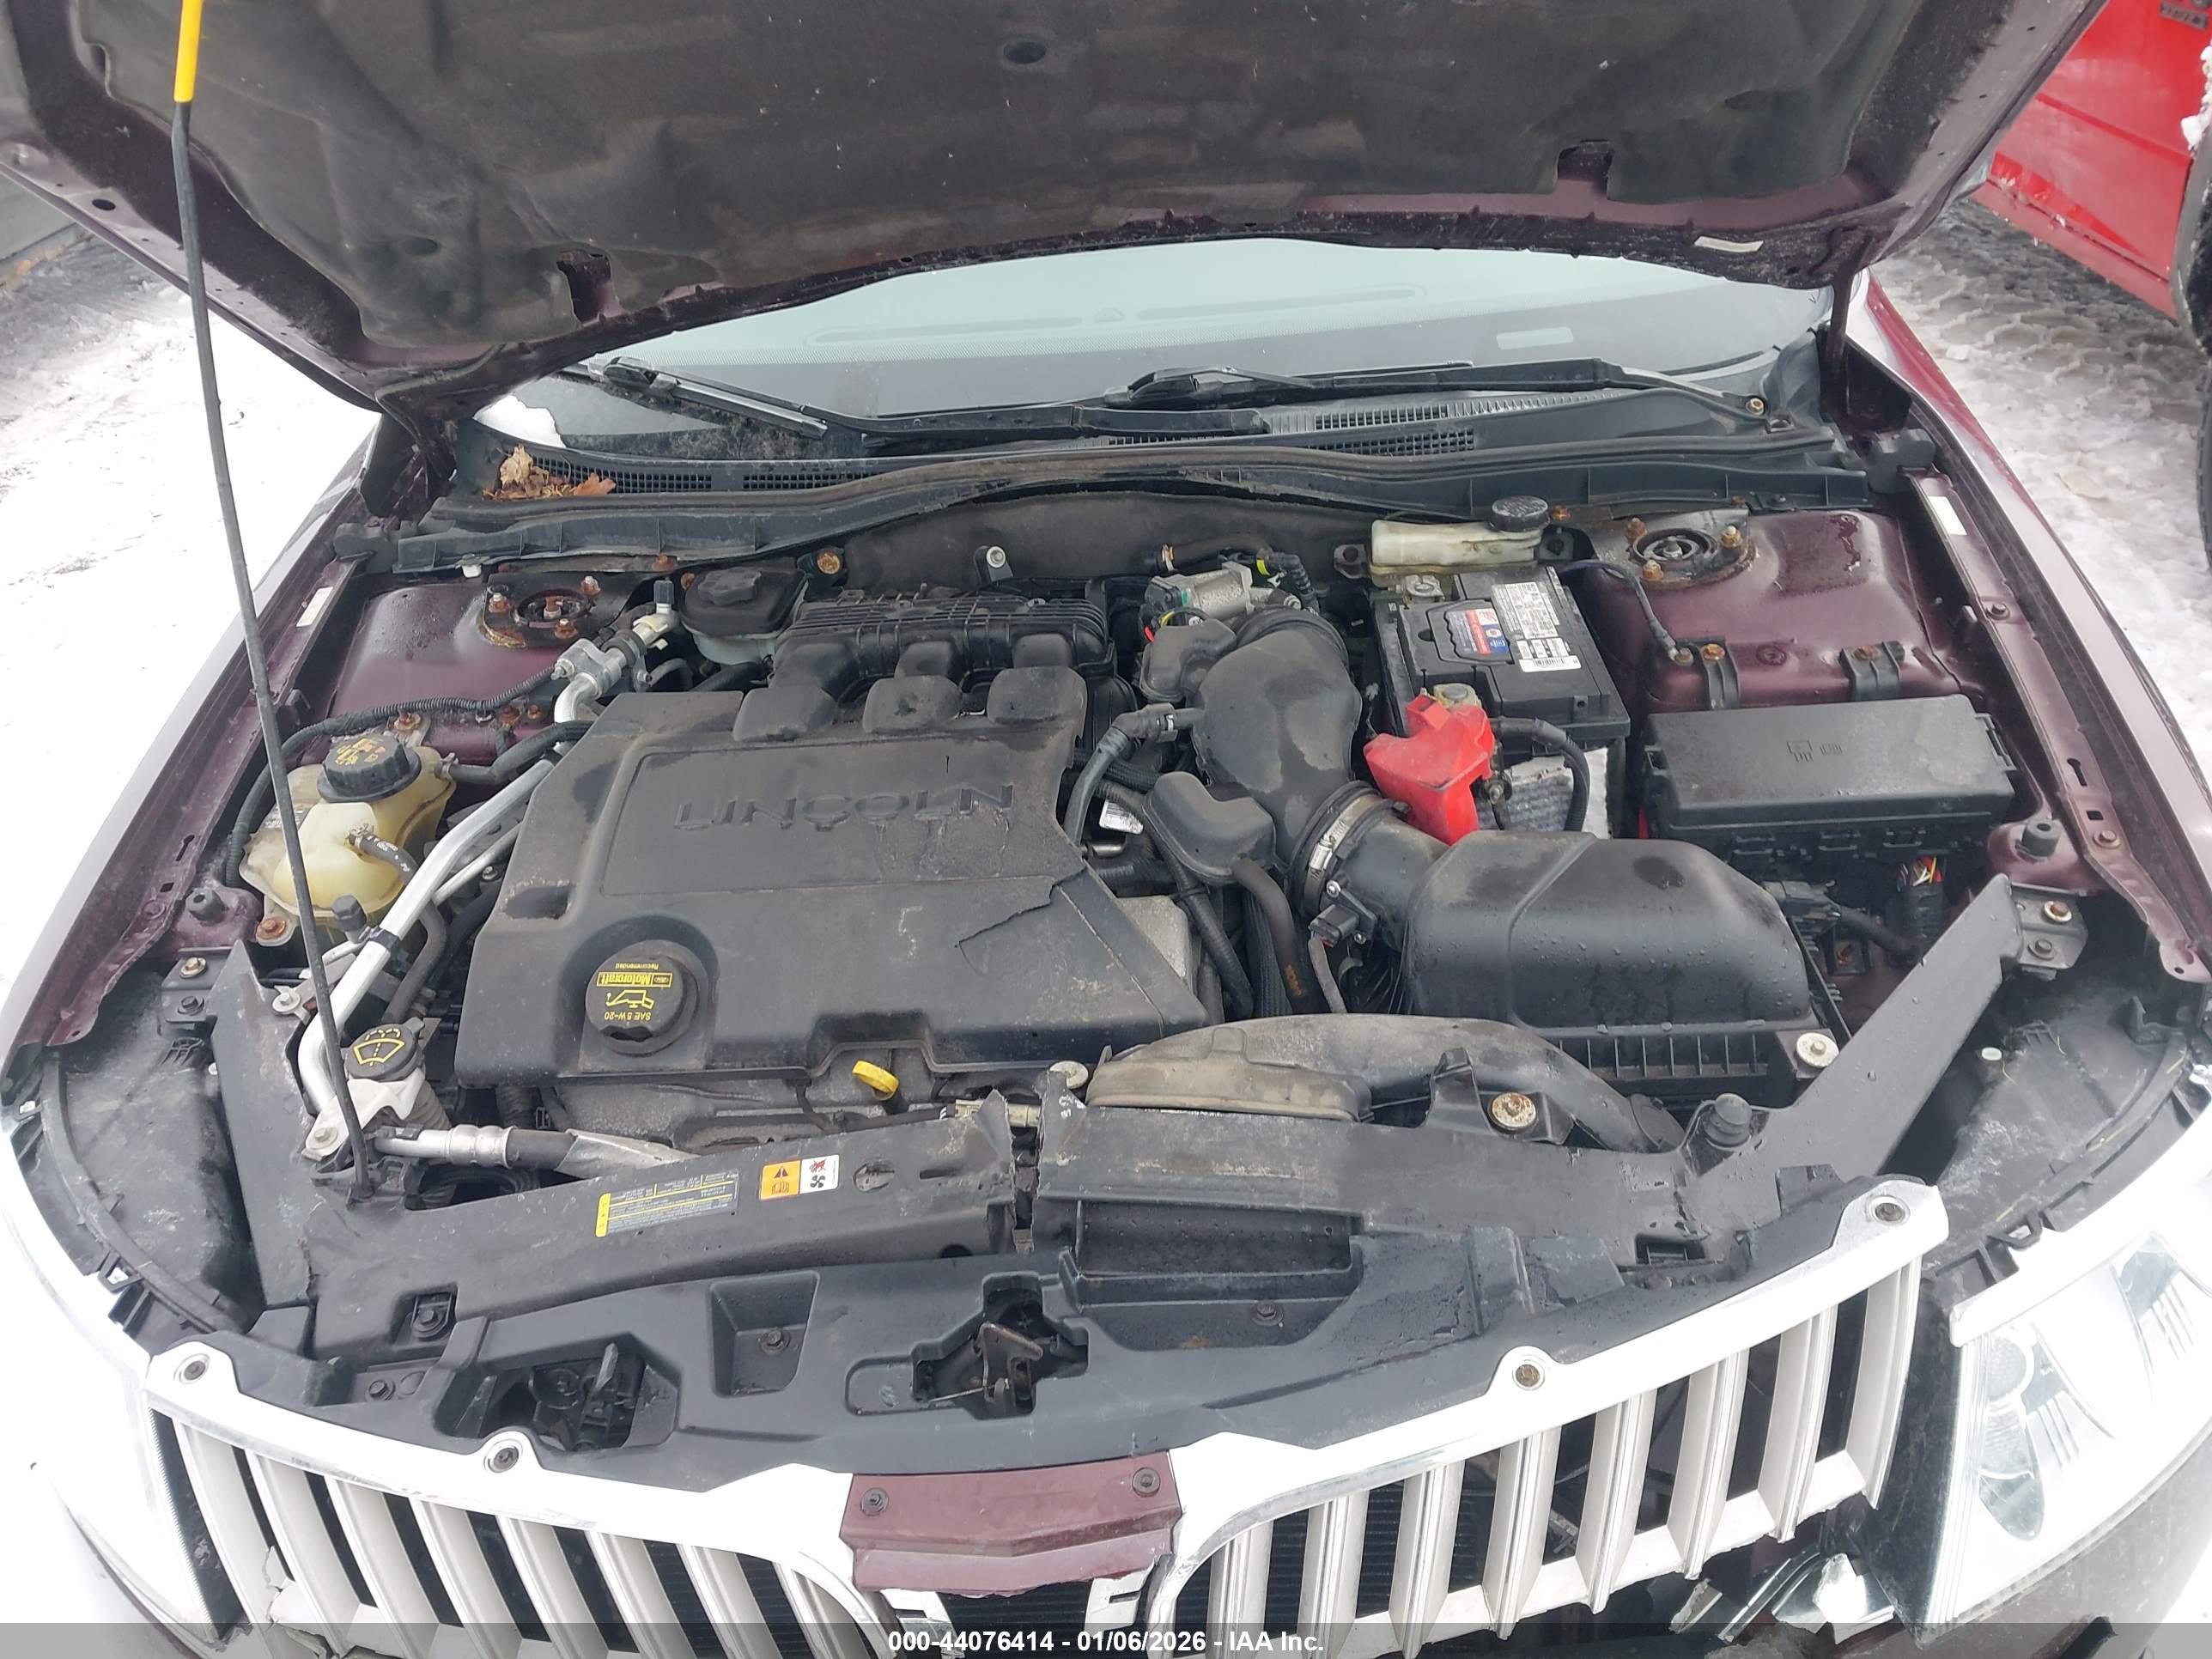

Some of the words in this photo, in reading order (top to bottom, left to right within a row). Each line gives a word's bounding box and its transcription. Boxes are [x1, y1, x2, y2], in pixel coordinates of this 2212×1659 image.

[673, 784, 1014, 831] LINCOLN
[601, 973, 651, 985] Motorcraft
[605, 1012, 632, 1021] 5W-20
[635, 1012, 652, 1021] SAE
